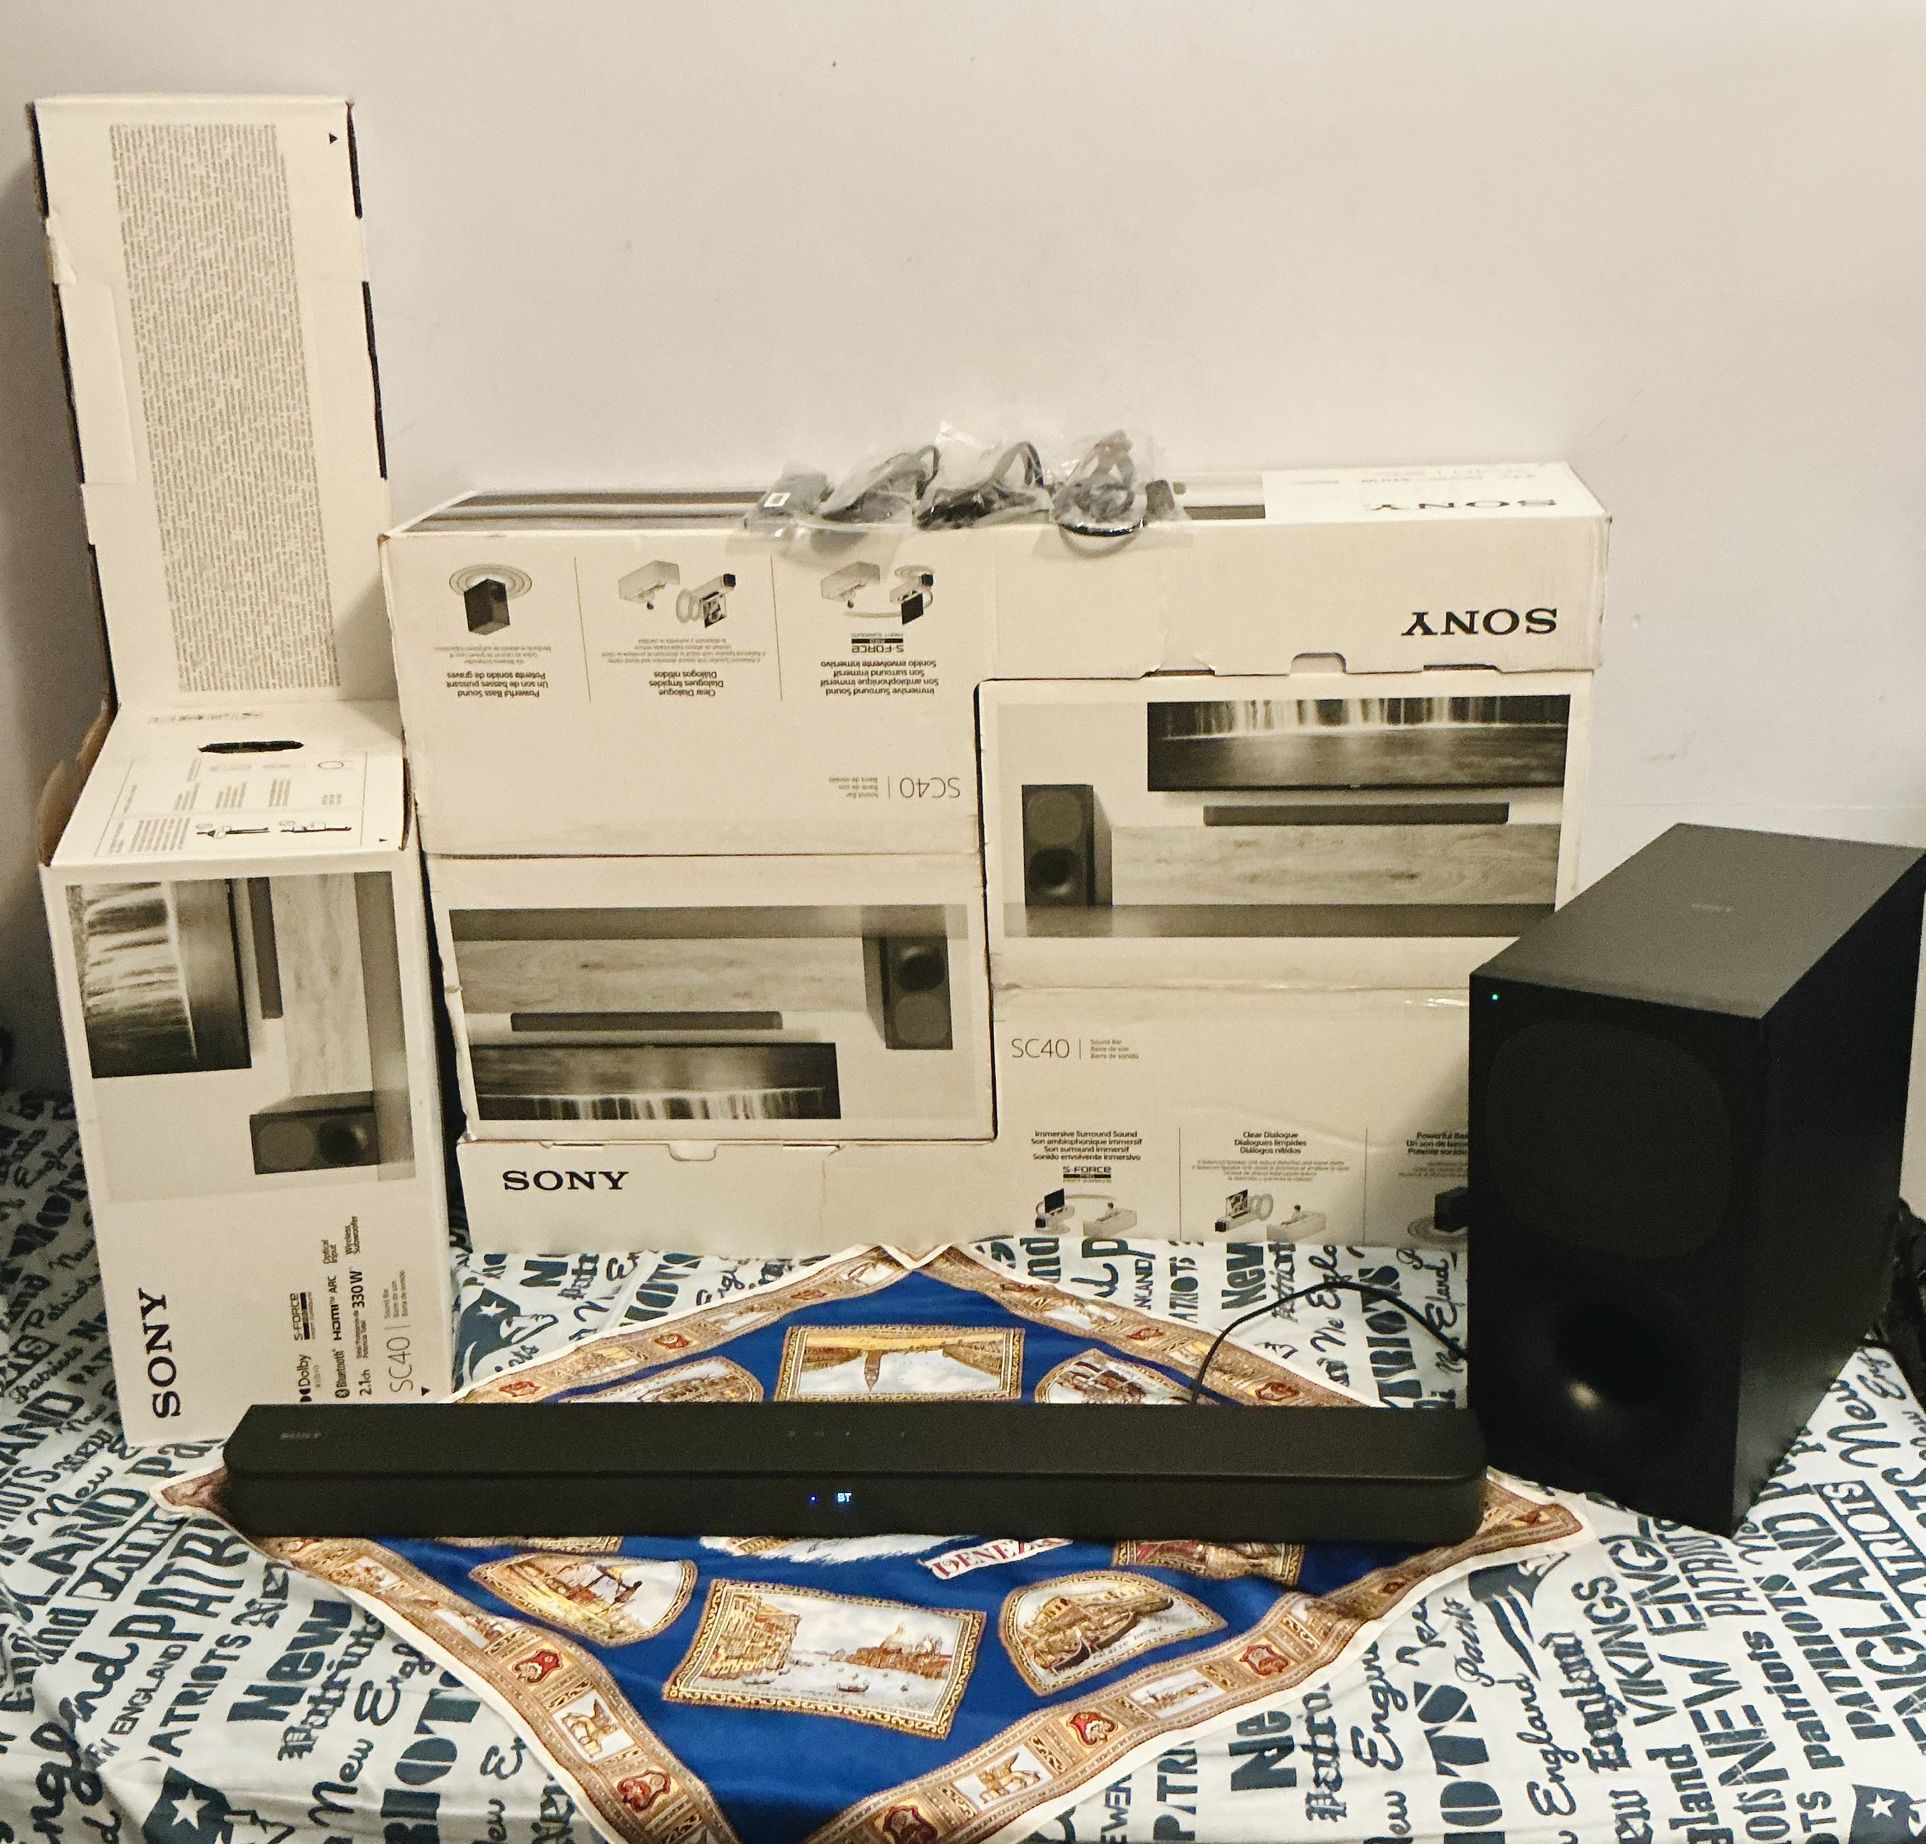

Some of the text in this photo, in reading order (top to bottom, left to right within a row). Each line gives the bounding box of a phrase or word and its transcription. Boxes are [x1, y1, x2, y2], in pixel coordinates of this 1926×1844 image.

[1401, 607, 1558, 637] SONY
[834, 669, 925, 678] Son surround immersif
[862, 660, 906, 668] envolvente
[908, 660, 937, 668] Sonido
[447, 671, 473, 679] graves
[487, 672, 513, 680] sonido
[685, 679, 724, 688] Dialogues
[820, 679, 856, 687] immersif
[923, 678, 939, 686] Son
[458, 690, 540, 698] Powerful Bass Sound
[659, 688, 716, 697] Clear Dialogue
[826, 687, 935, 696] Immersive Surround Sound
[900, 777, 961, 799] SC40
[1011, 1038, 1070, 1059] SC40
[1076, 1130, 1112, 1138] Surround
[1113, 1130, 1138, 1138] Sound
[1263, 1131, 1298, 1139] Dialogue
[502, 1170, 629, 1191] SONY
[320, 1239, 332, 1264] Optical
[329, 1243, 338, 1264] Input
[327, 1275, 338, 1294] ARC
[349, 1270, 365, 1309] 330 W
[138, 1288, 181, 1418] SONY
[297, 1355, 312, 1387] Dolby
[386, 1336, 414, 1393] SC40
[358, 1369, 372, 1396] 2.1ch
[0, 1391, 85, 1470] AND
[28, 1466, 114, 1526] New
[837, 1492, 852, 1503] BT
[22, 1487, 151, 1622] LAND
[227, 1599, 354, 1723] New
[1753, 1572, 1896, 1740] PATRIOTS
[109, 1643, 190, 1746] ENGLAND
[140, 1632, 253, 1759] ATRIOTS
[1657, 1652, 1790, 1787] NEW
[1496, 1674, 1579, 1818] England
[308, 1738, 375, 1829] New
